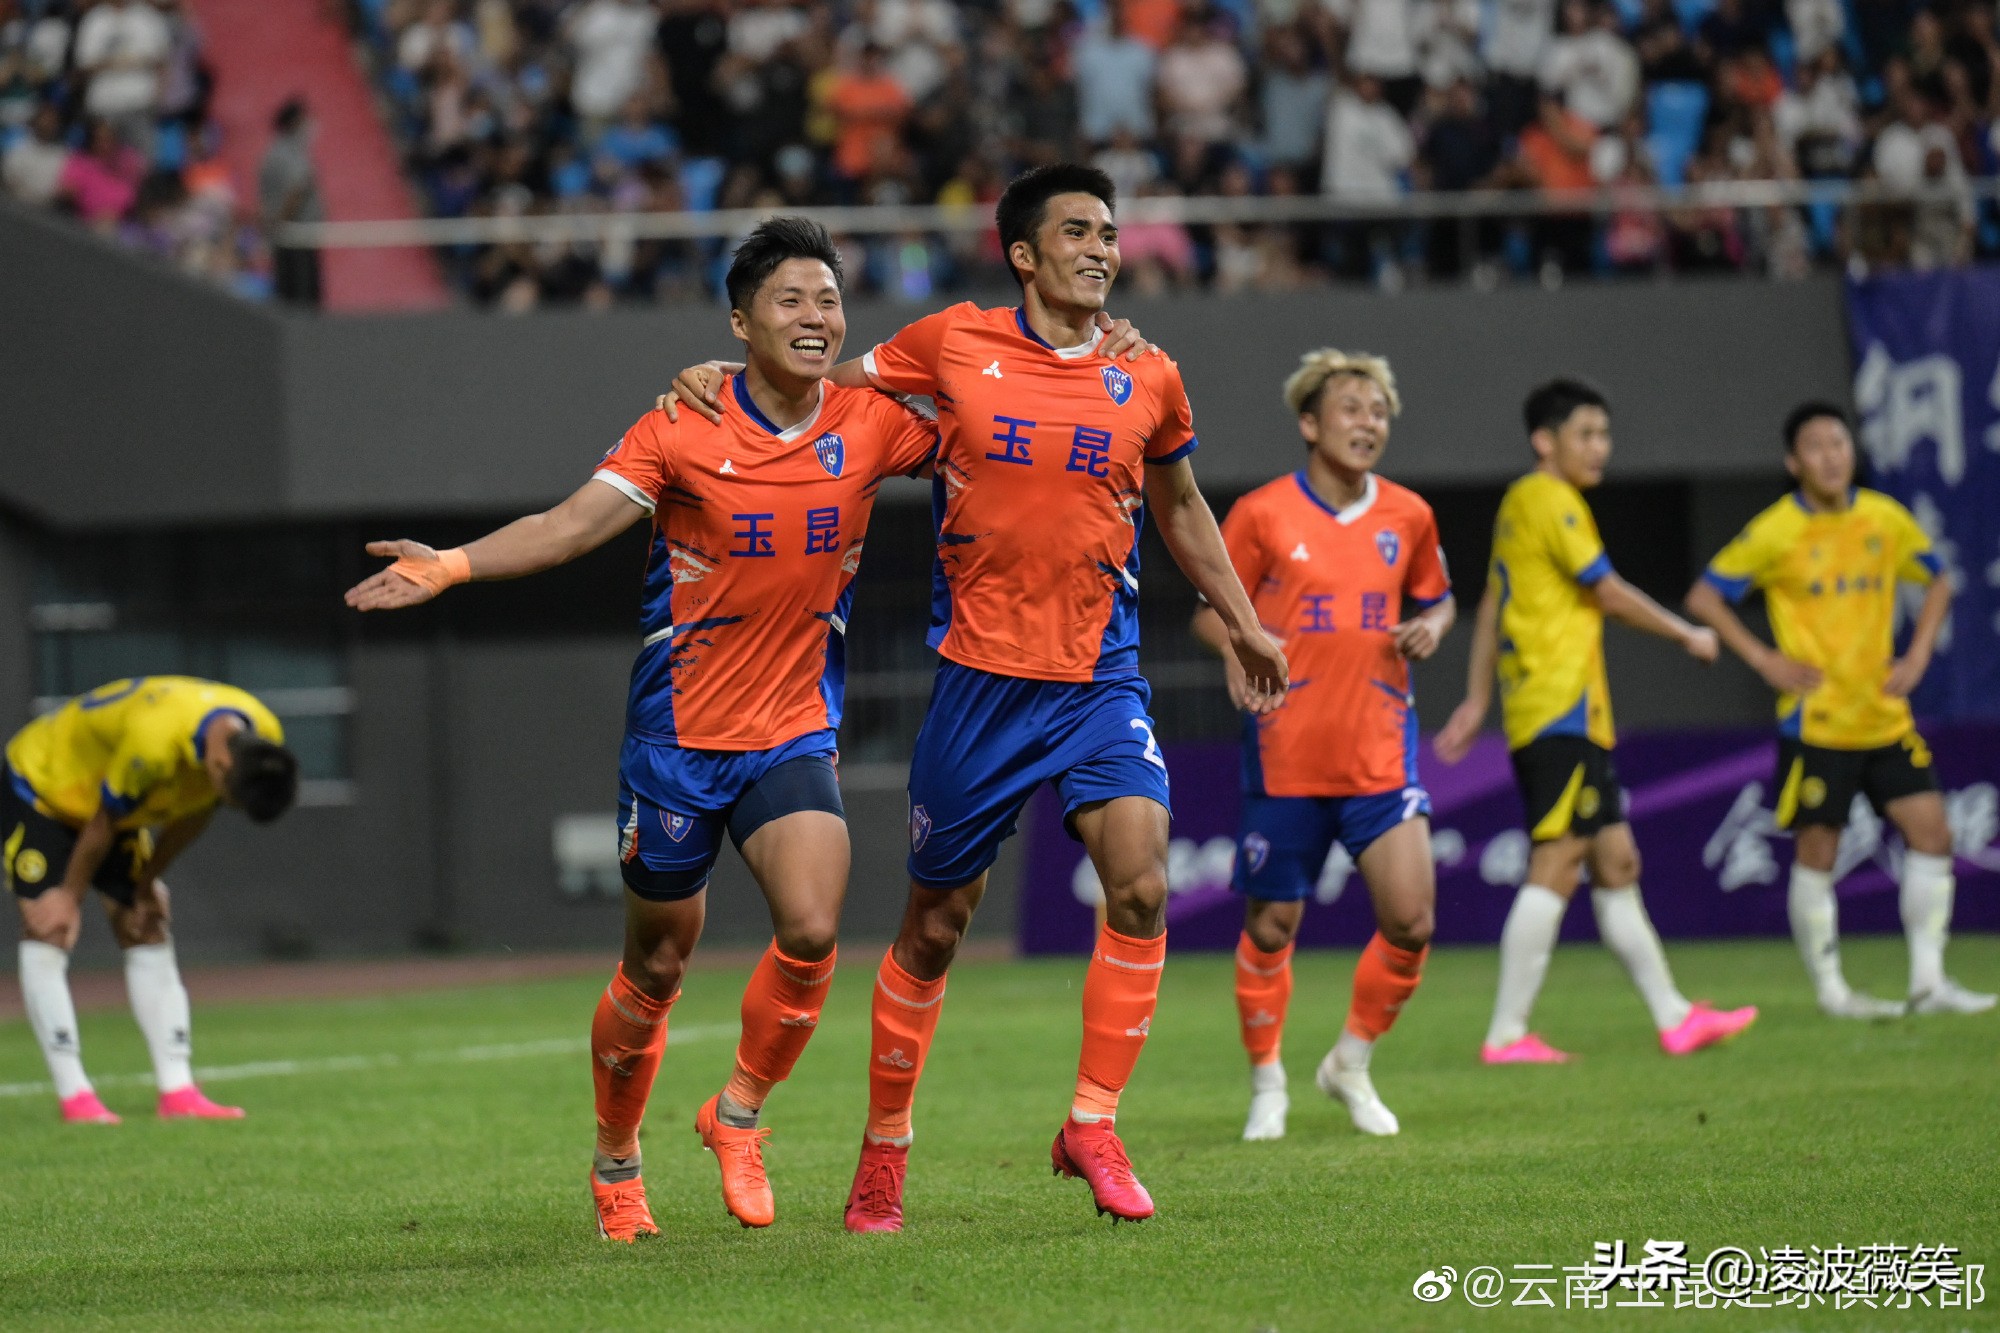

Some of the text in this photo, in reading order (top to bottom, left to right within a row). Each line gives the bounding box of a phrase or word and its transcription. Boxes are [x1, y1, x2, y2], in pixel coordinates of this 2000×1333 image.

[1103, 368, 1129, 382] YNYK
[815, 435, 840, 449] YNYK
[986, 415, 1112, 478] 玉昆
[729, 507, 839, 557] 玉昆
[1299, 592, 1389, 632] 玉昆
